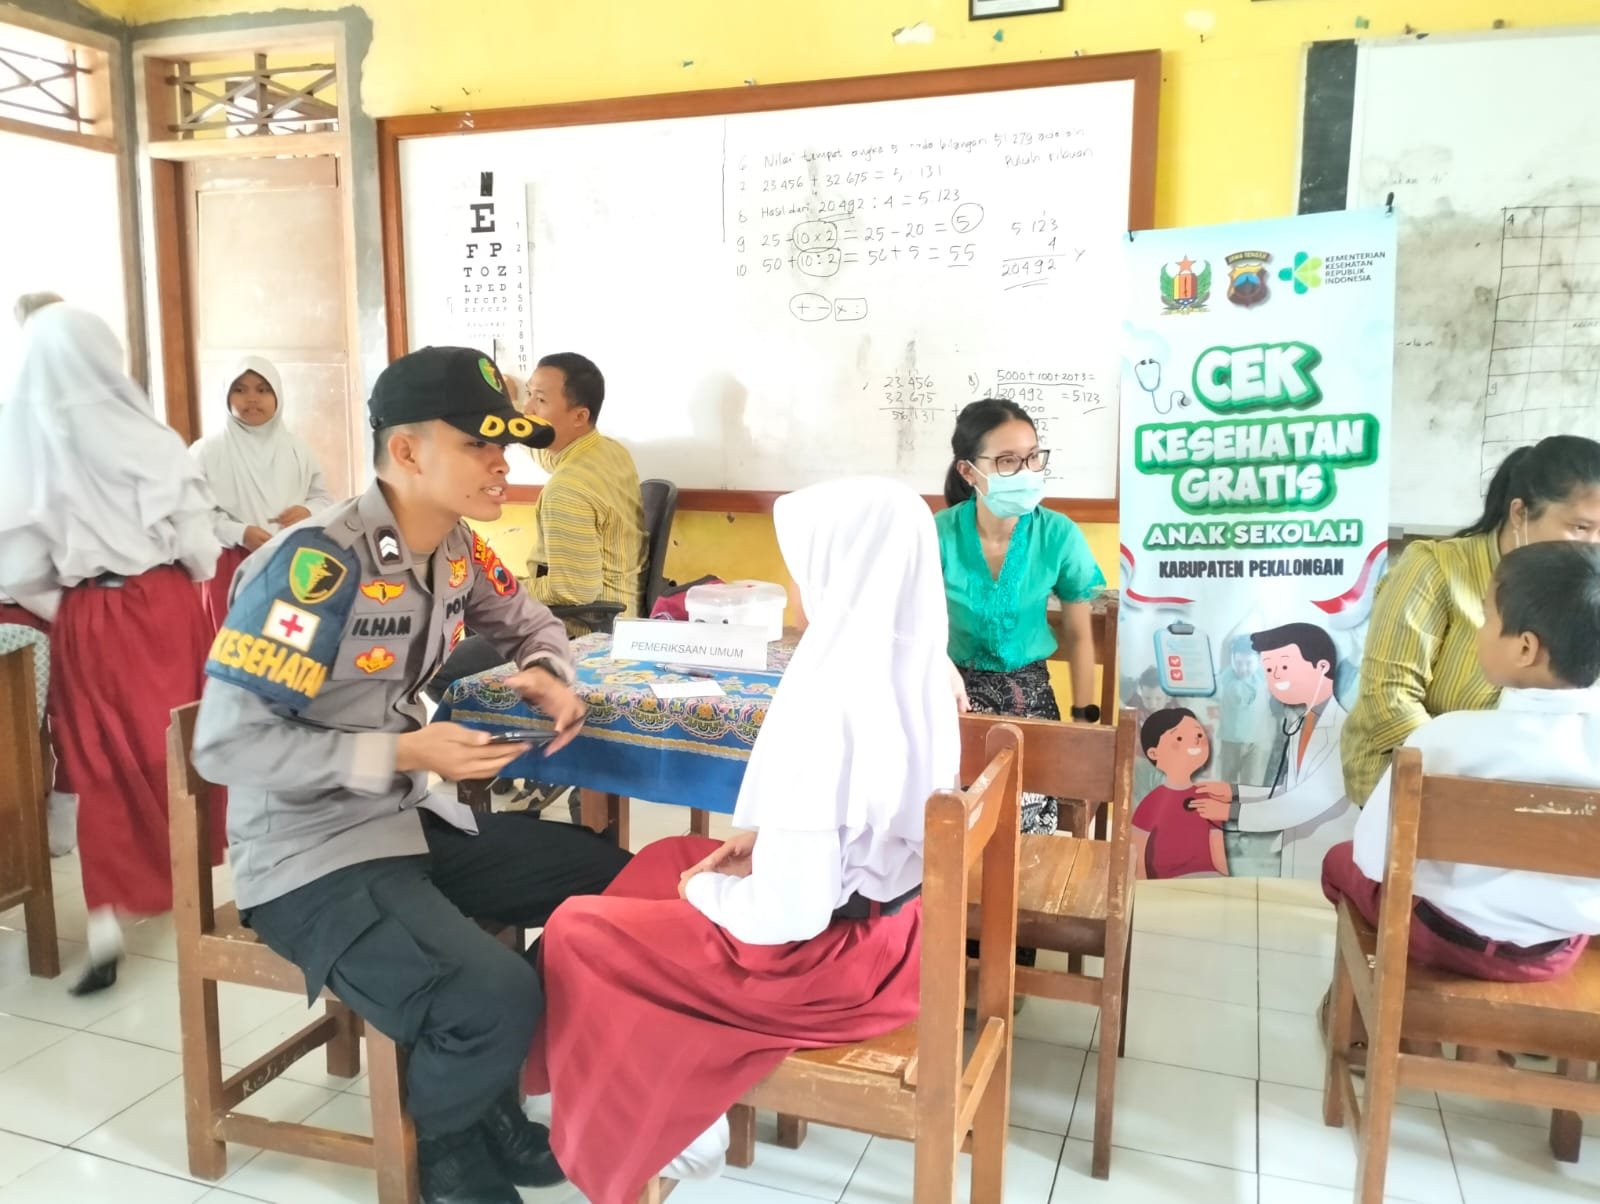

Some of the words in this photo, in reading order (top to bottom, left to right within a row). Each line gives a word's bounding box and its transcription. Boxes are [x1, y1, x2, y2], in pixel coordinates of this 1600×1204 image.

[764, 151, 795, 168] Nilai
[470, 203, 496, 233] E
[1325, 251, 1386, 262] KEMENTERIAN
[1325, 260, 1373, 270] KESEHATAN
[1325, 268, 1365, 277] REPUBLIK
[1325, 275, 1372, 285] INDONESIA
[1200, 344, 1309, 405] CEK
[1141, 419, 1366, 464] KESEHATAN
[1178, 465, 1326, 506] GRATIS
[1147, 525, 1225, 545] ANAK
[1235, 522, 1359, 544] SEKOLAH
[1159, 562, 1244, 578] KABUPATEN
[1249, 558, 1344, 578] PEKALONGAN
[352, 616, 411, 636] ILHAM
[631, 641, 707, 655] PEMERIKSAAN
[709, 645, 744, 658] UMUM
